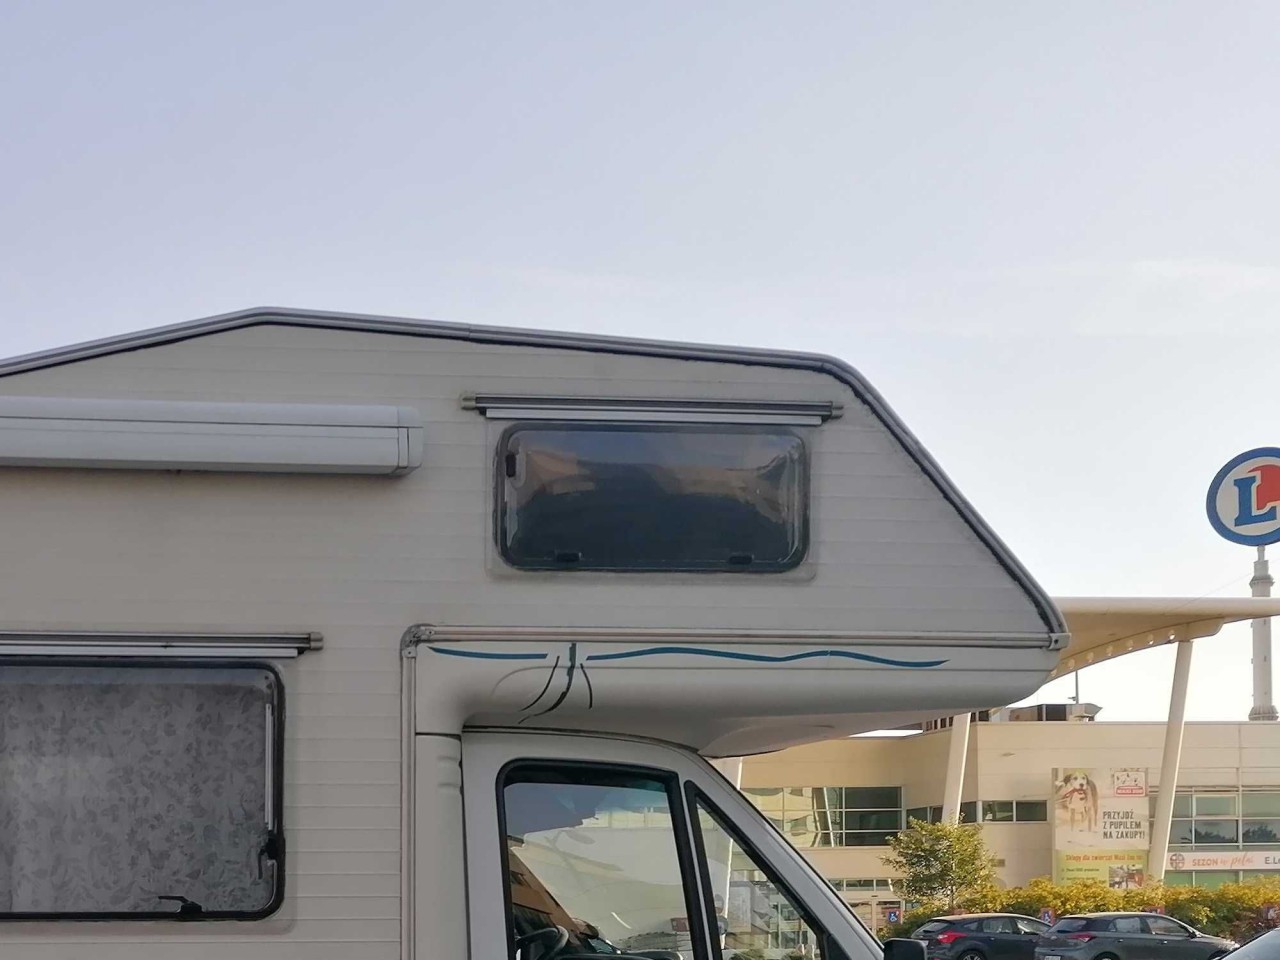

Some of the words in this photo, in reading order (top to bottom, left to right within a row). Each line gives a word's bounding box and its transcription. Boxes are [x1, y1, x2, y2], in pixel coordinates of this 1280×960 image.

[1102, 809, 1134, 819] PRZYJDŹ
[1103, 821, 1107, 829] Z
[1109, 821, 1141, 829] PUPILEM
[1103, 831, 1113, 839] NA
[1116, 830, 1145, 839] ZAKUPY!
[1192, 857, 1218, 866] SEZON
